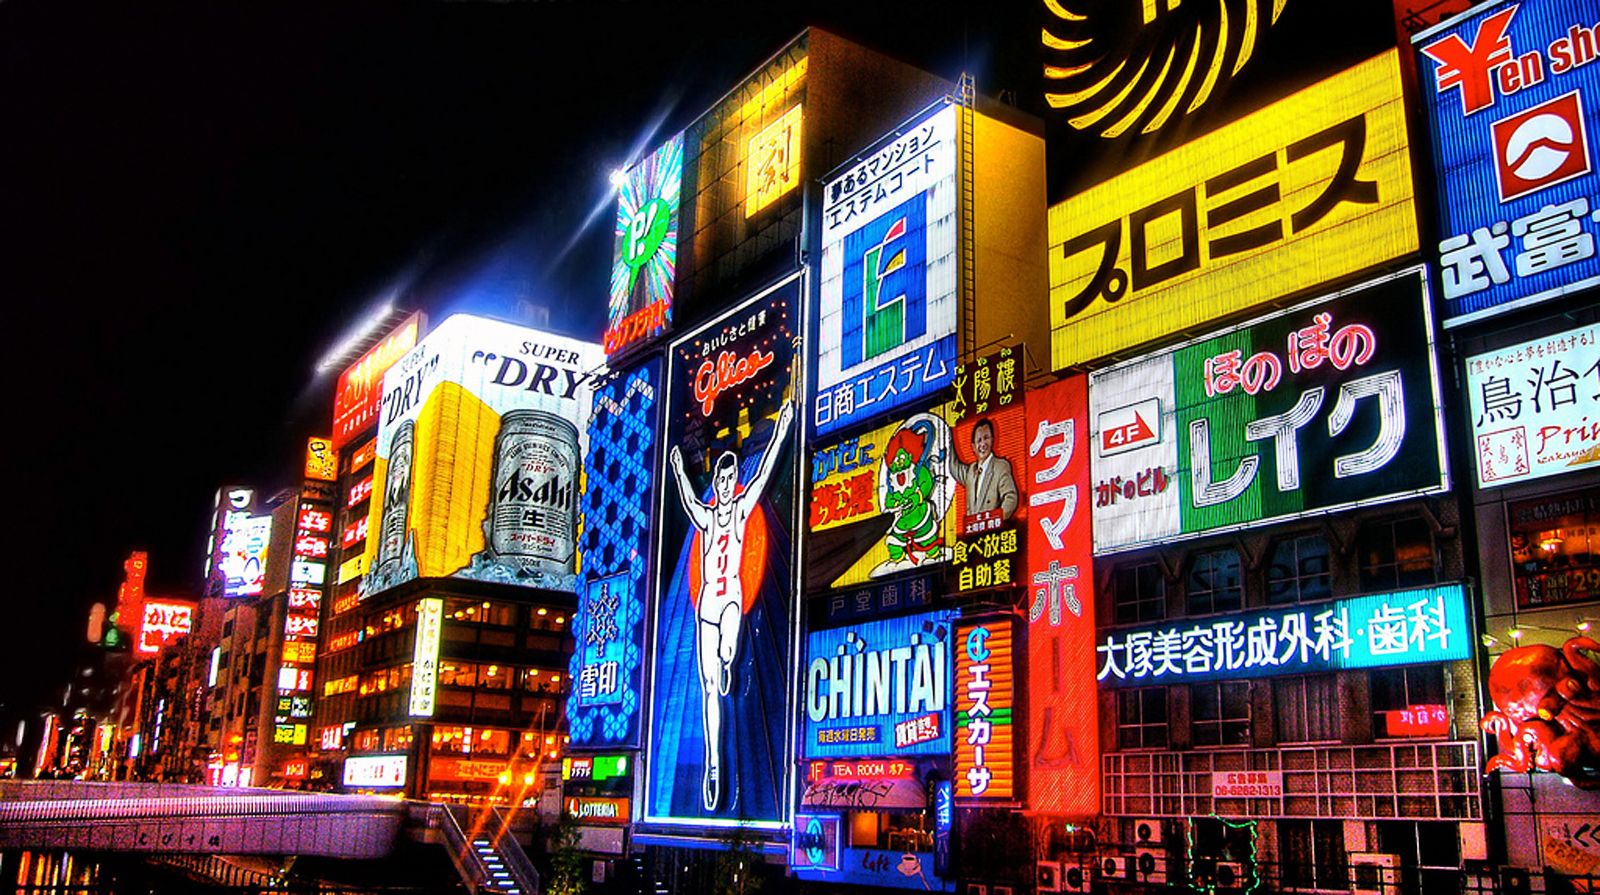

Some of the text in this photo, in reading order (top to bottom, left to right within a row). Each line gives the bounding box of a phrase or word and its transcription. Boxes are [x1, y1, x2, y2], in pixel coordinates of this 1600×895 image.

[831, 126, 934, 204] 夢あるマンション
[829, 153, 935, 230] エステムコート
[1063, 113, 1380, 320] プロミス
[1439, 198, 1600, 300] 武富
[519, 341, 580, 366] SUPER
[702, 310, 766, 356] おいしさと健康
[695, 350, 774, 417] Glico
[815, 347, 947, 427] 日商エステム
[1109, 424, 1139, 445] 4F
[1189, 370, 1406, 508] レイク
[812, 437, 875, 483] かぜに
[500, 468, 572, 512] Asahi
[1096, 466, 1169, 508] カドのビル
[522, 510, 545, 528] 生
[716, 533, 729, 596] グリコ
[953, 529, 1018, 565] 食べ放題
[959, 559, 1010, 591] 自助餐
[148, 608, 190, 628] かに
[1096, 595, 1452, 682] 大塚美容形成外科・歯科
[580, 660, 618, 699] 雪印
[808, 632, 945, 722] CHINTAI
[818, 727, 876, 743] 毎週水曜日発売
[966, 664, 993, 797] エスカーサ
[811, 763, 824, 781] 1F
[833, 764, 853, 776] TEA
[857, 764, 884, 776] ROOM
[1215, 785, 1280, 796] 06-6262-1313
[579, 800, 616, 818] LOTTERIA
